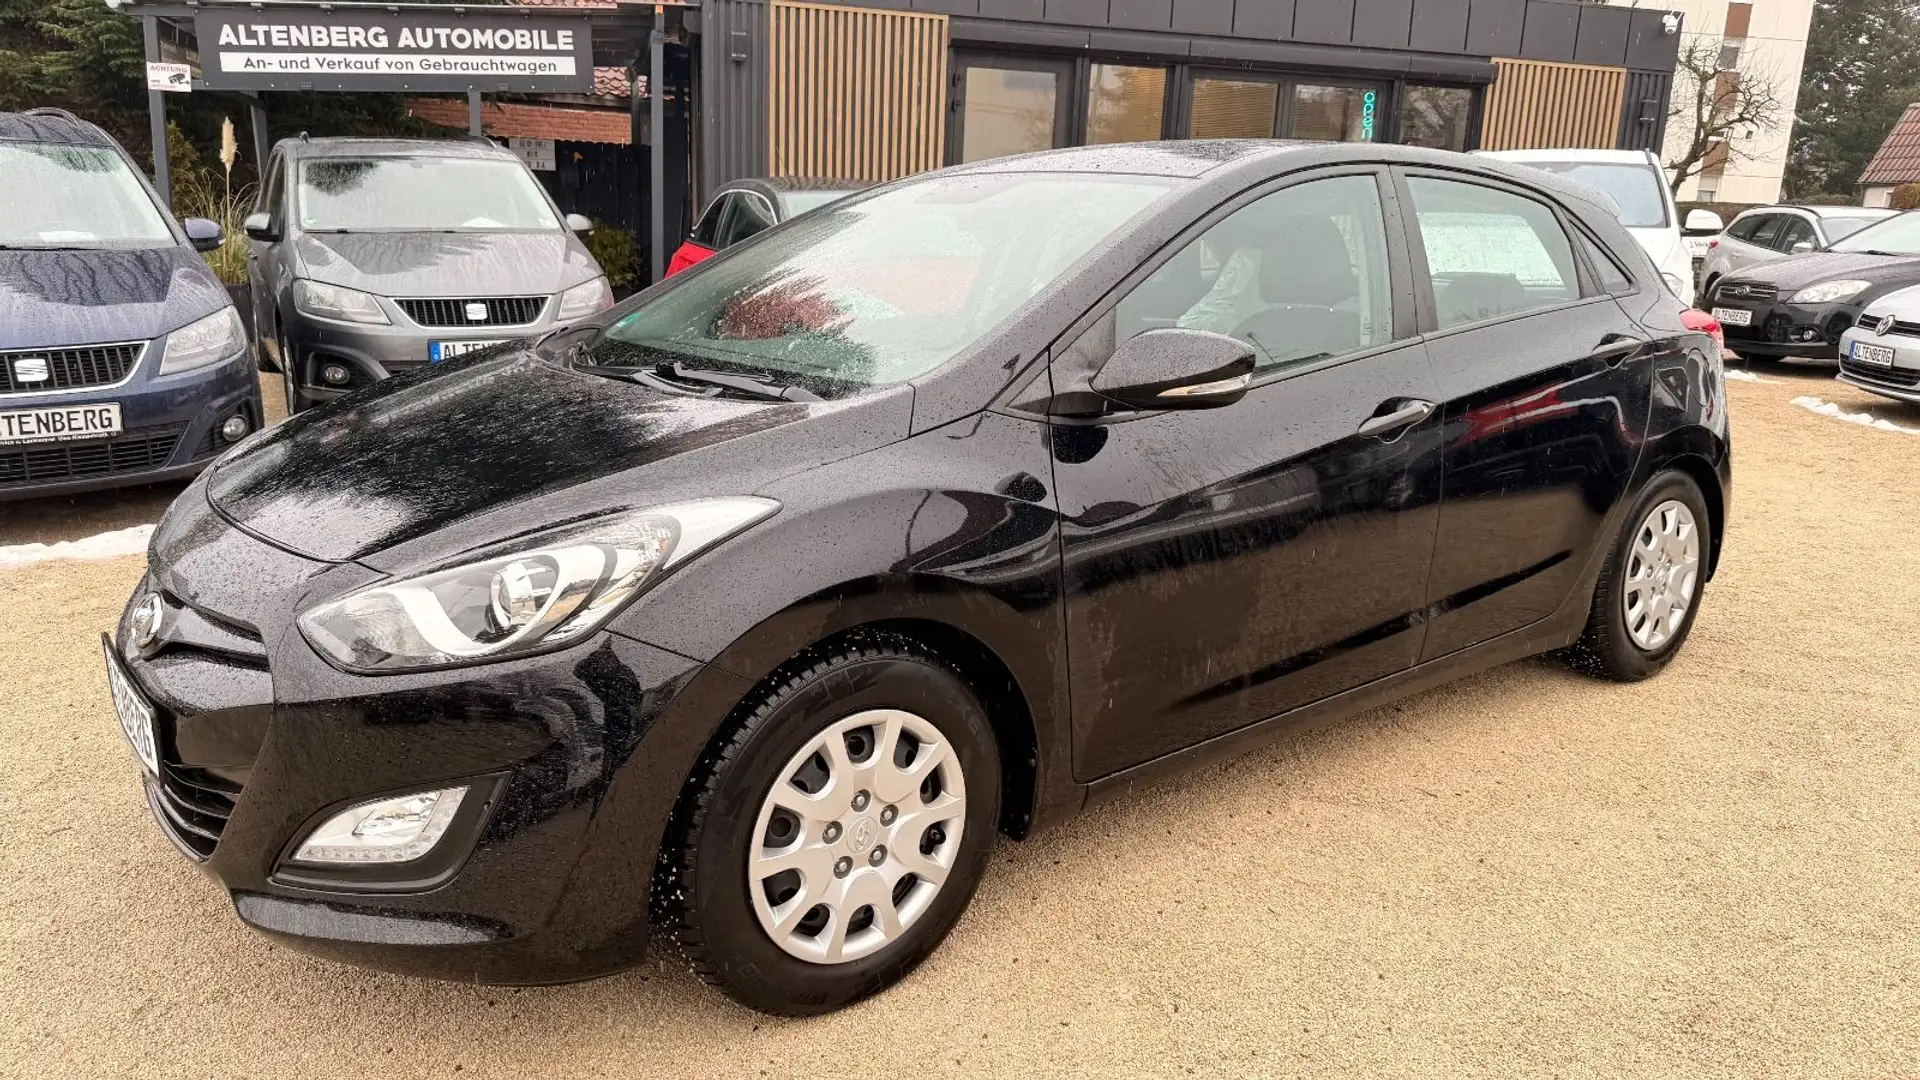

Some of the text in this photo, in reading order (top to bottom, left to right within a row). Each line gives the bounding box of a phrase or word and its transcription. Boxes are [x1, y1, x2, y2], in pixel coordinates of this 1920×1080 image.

[218, 23, 575, 51] ALTENBERG AUTOMOBILE
[150, 65, 187, 73] ACHTUNG
[244, 57, 557, 74] An- und Verkauf von Gebrauchtwagen
[1362, 92, 1375, 140] open
[1855, 344, 1891, 364] ALTENBERG
[0, 408, 112, 436] TENBERG
